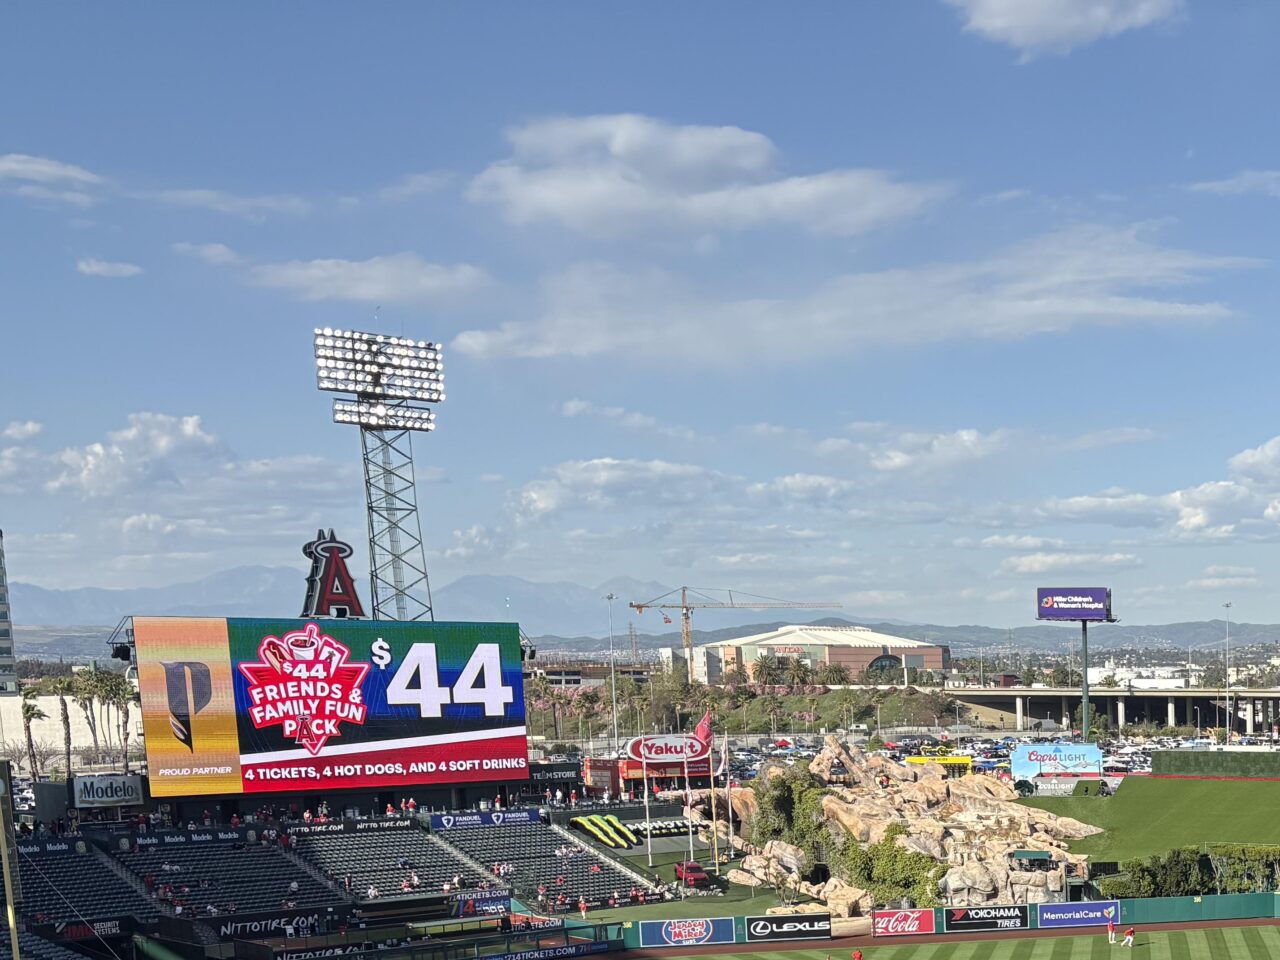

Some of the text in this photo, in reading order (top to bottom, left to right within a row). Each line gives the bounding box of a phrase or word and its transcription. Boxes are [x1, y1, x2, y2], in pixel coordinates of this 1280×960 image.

[282, 661, 327, 679] $44
[371, 638, 514, 718] $44
[251, 681, 362, 704] FRIENDS &
[251, 699, 363, 723] FAMILY FUN
[284, 716, 337, 743] PACK
[1028, 751, 1057, 762] Coors
[159, 766, 232, 776] PROUD PARTNER
[245, 757, 526, 780] 4 TICKETS, 4 HOT DOGS, AND 4 SOFT DRINKS
[553, 770, 577, 779] STORE
[82, 777, 134, 800] Modelo
[310, 824, 344, 832] TIRE.COM
[356, 819, 410, 829] NITTO TIRE.COM
[164, 835, 186, 843] Modelo
[192, 833, 212, 841] Modelo
[218, 831, 239, 840] Modelo
[136, 837, 158, 845] Modelo
[18, 845, 40, 853] Modelo
[46, 843, 68, 851] Modelo
[968, 907, 1022, 919] YOKOHAMA
[1043, 910, 1102, 920] MemorialCare
[93, 920, 120, 929] SECURITY
[668, 920, 706, 931] Jersey
[772, 920, 831, 931] LEXUS
[997, 918, 1021, 928] TIRES
[95, 927, 120, 936] SYSTEMS
